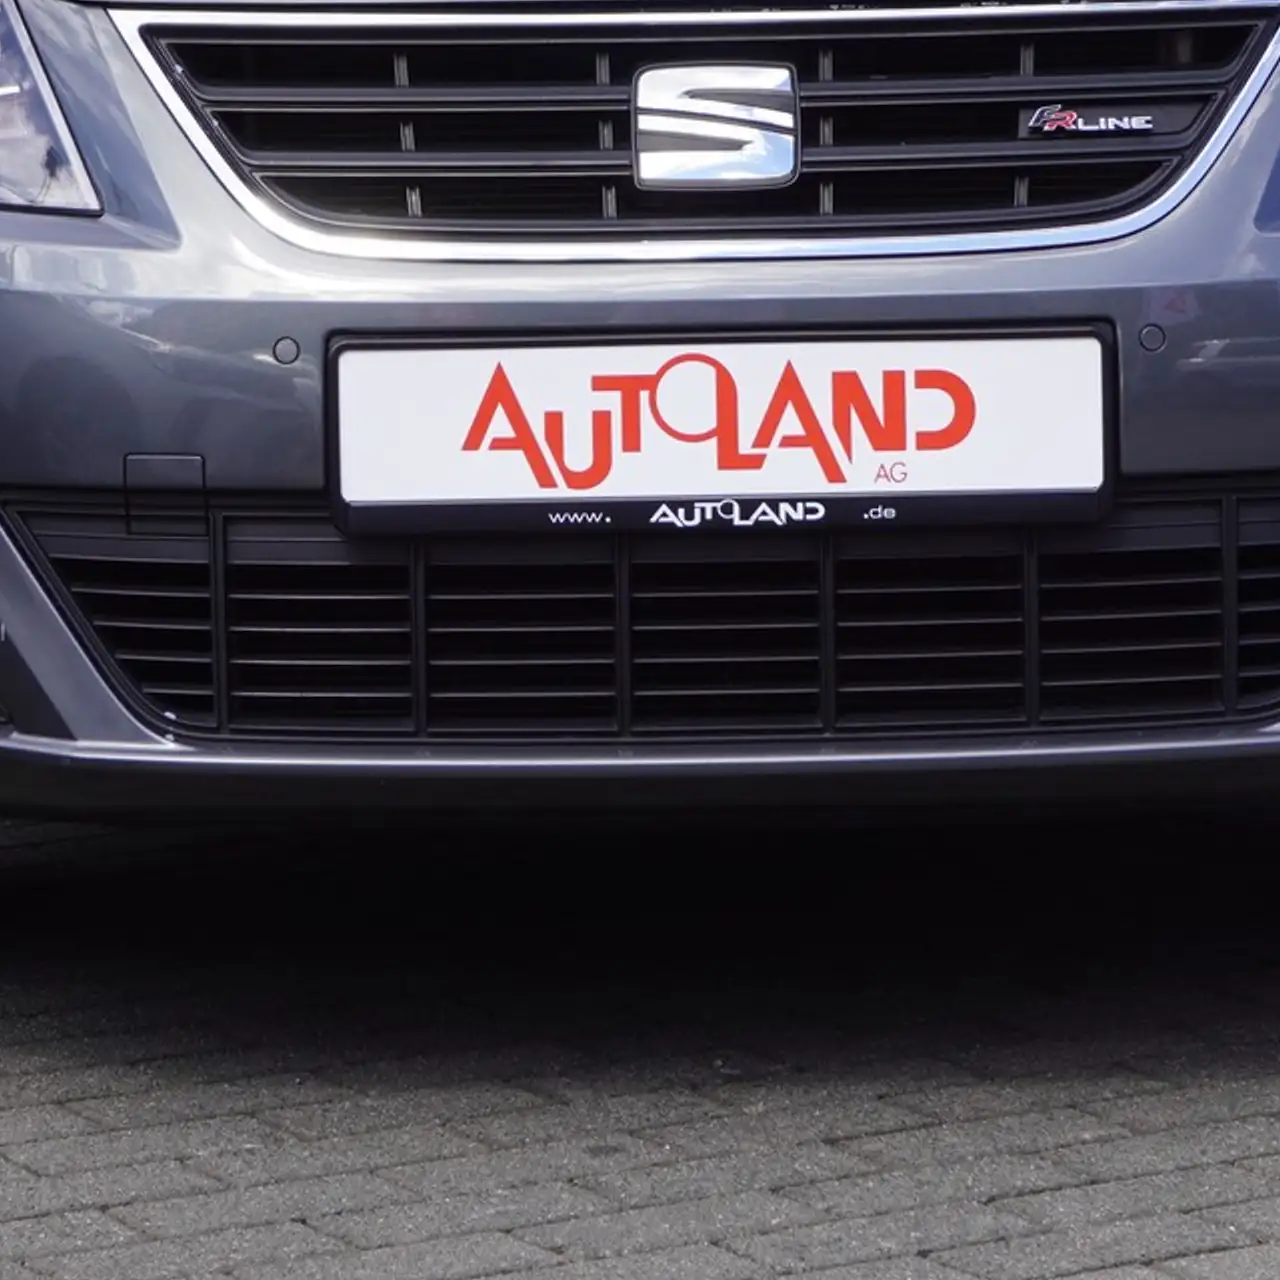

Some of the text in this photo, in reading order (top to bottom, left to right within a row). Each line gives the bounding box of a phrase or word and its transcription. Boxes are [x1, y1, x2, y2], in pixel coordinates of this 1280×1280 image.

[461, 353, 977, 490] AUTOLAND
[874, 461, 908, 484] AG
[548, 499, 897, 528] www. AUTOLAND .de
